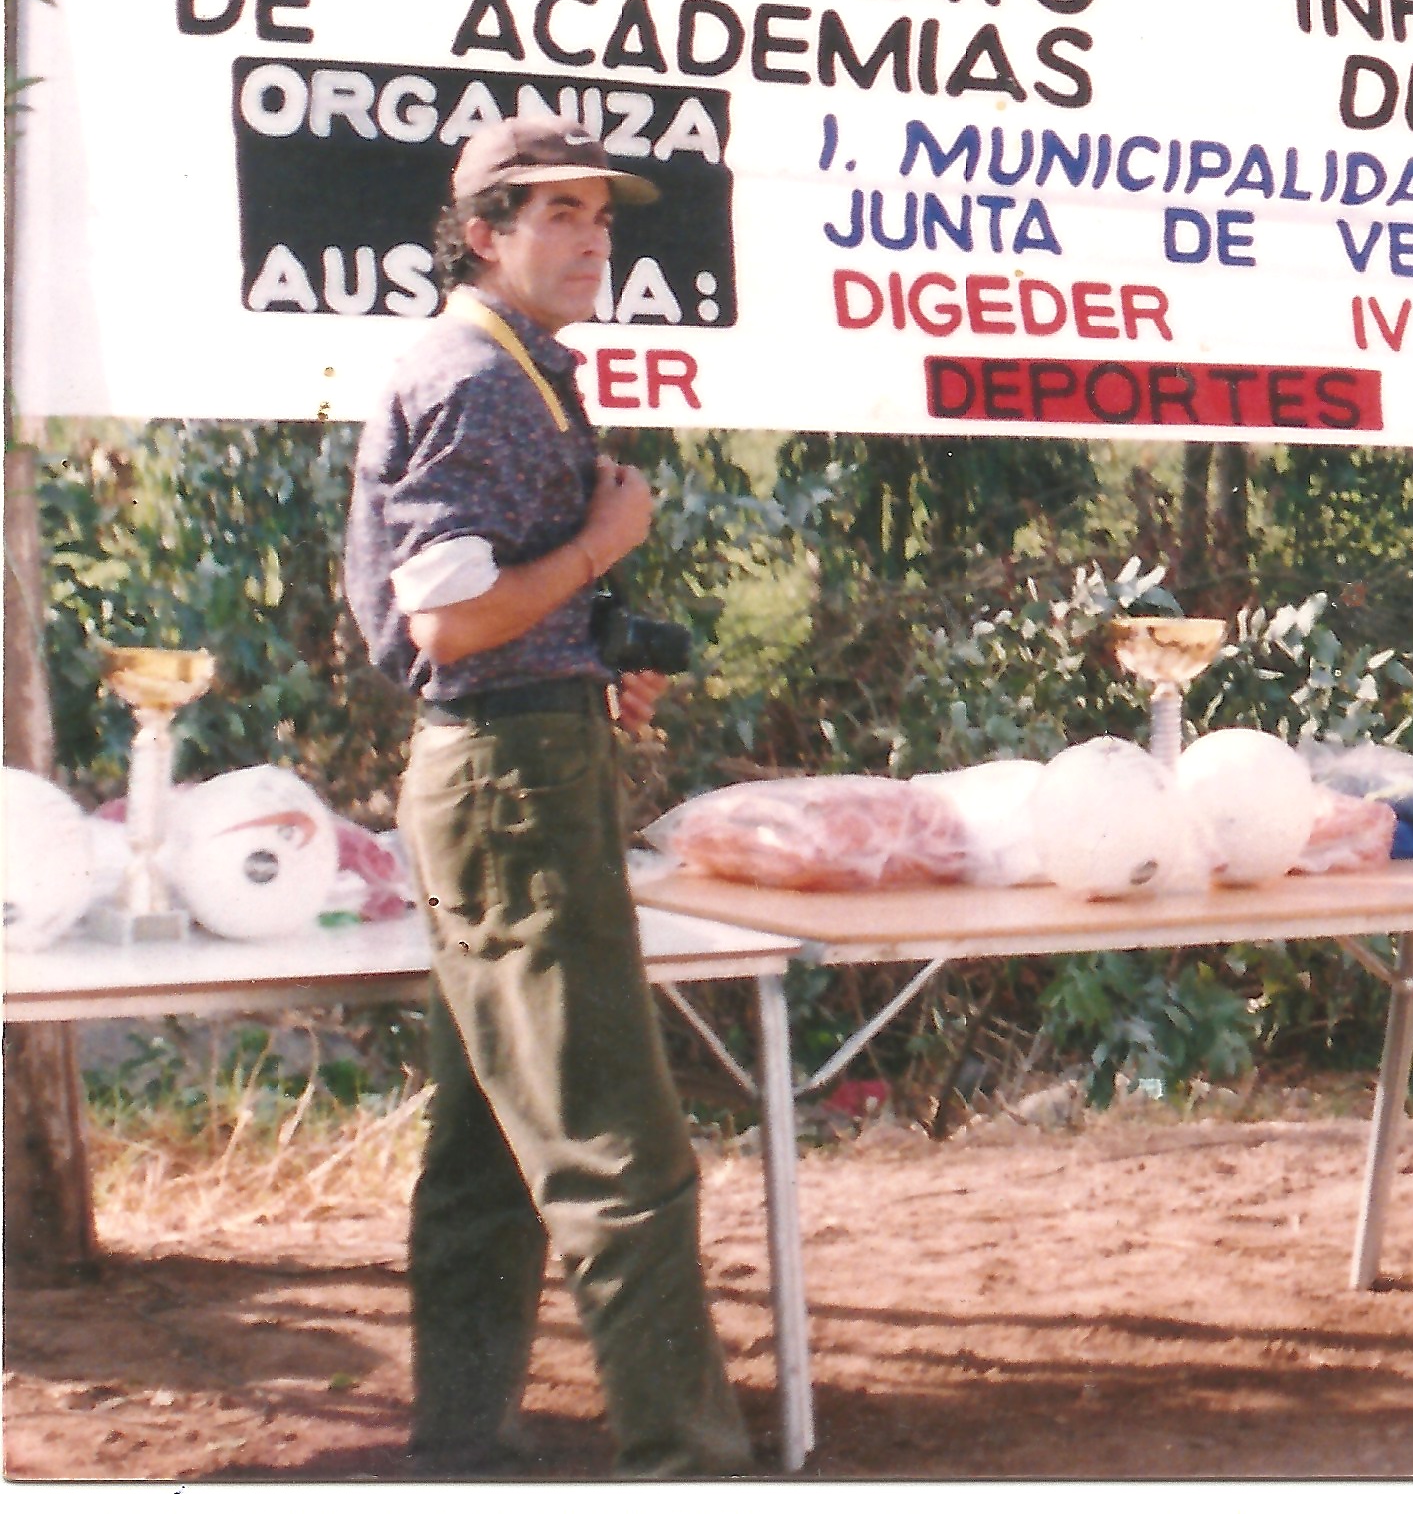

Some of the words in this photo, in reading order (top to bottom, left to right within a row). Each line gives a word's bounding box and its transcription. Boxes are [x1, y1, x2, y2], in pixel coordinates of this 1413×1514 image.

[240, 64, 722, 163] ORGANIZA
[817, 114, 856, 171] I.
[824, 189, 1062, 255] JUNTA
[1164, 207, 1256, 266] DE
[833, 269, 1173, 341] DIGEDER
[1352, 296, 1411, 351] IV
[929, 359, 1362, 428] DEPORTES
